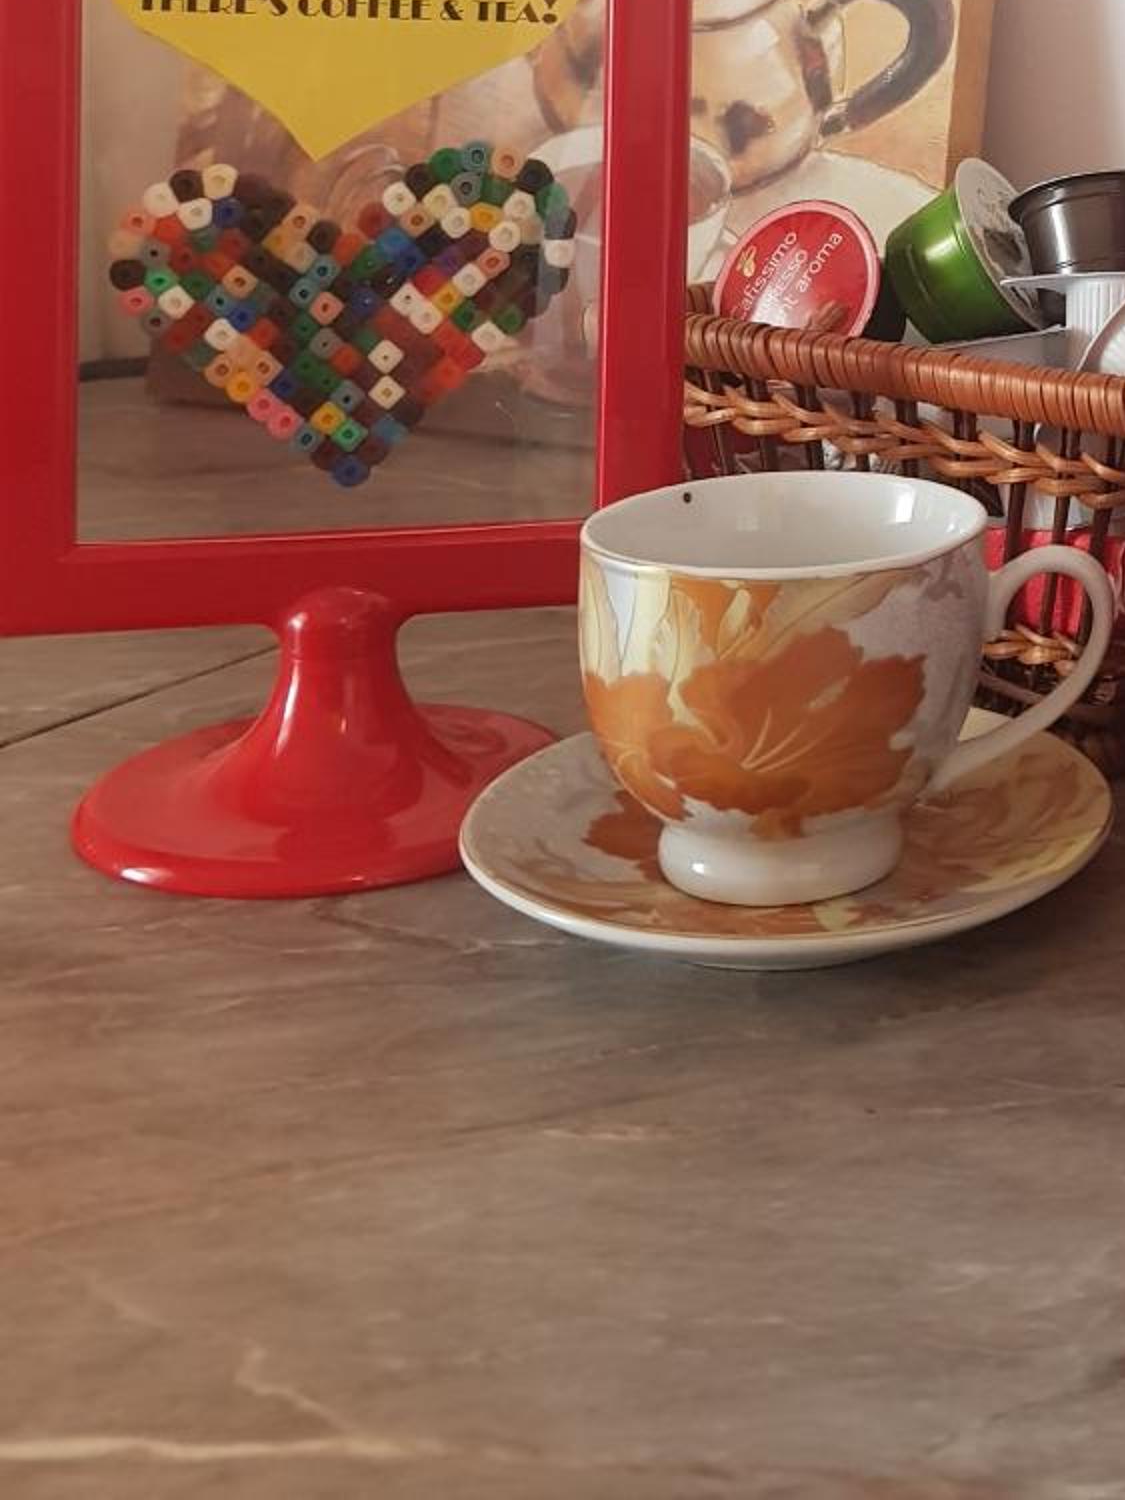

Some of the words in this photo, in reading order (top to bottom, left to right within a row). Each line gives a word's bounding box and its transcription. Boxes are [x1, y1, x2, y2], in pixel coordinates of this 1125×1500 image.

[439, 0, 464, 22] &
[730, 231, 797, 321] Cafissimo
[796, 233, 843, 293] aroma
